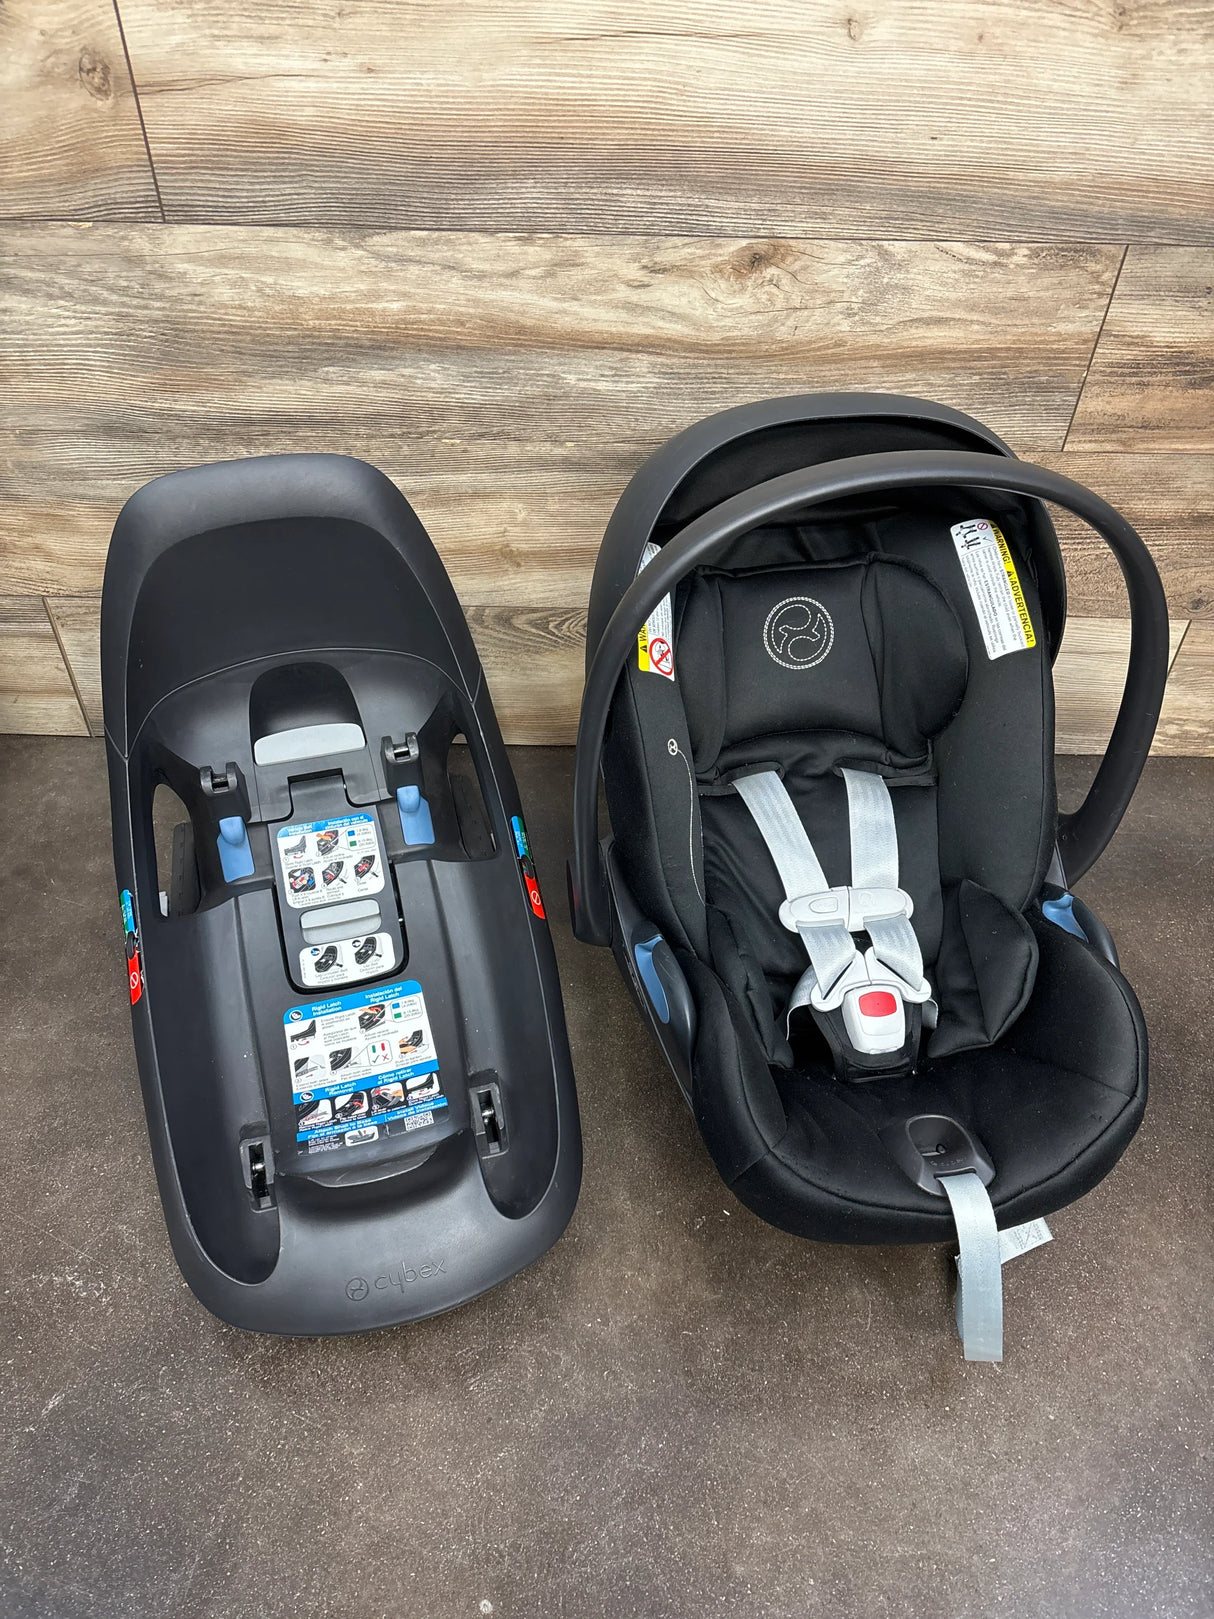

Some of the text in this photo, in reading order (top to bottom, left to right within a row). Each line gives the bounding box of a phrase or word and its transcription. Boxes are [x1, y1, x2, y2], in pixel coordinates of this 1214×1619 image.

[992, 528, 1011, 564] WARNING!
[369, 991, 399, 1003] Rigid Latch
[311, 999, 341, 1012] Rigid Latch
[383, 1076, 398, 1084] Rigid
[324, 1085, 339, 1093] Rigid
[340, 1081, 356, 1089] Latch
[374, 1259, 448, 1294] cybex
